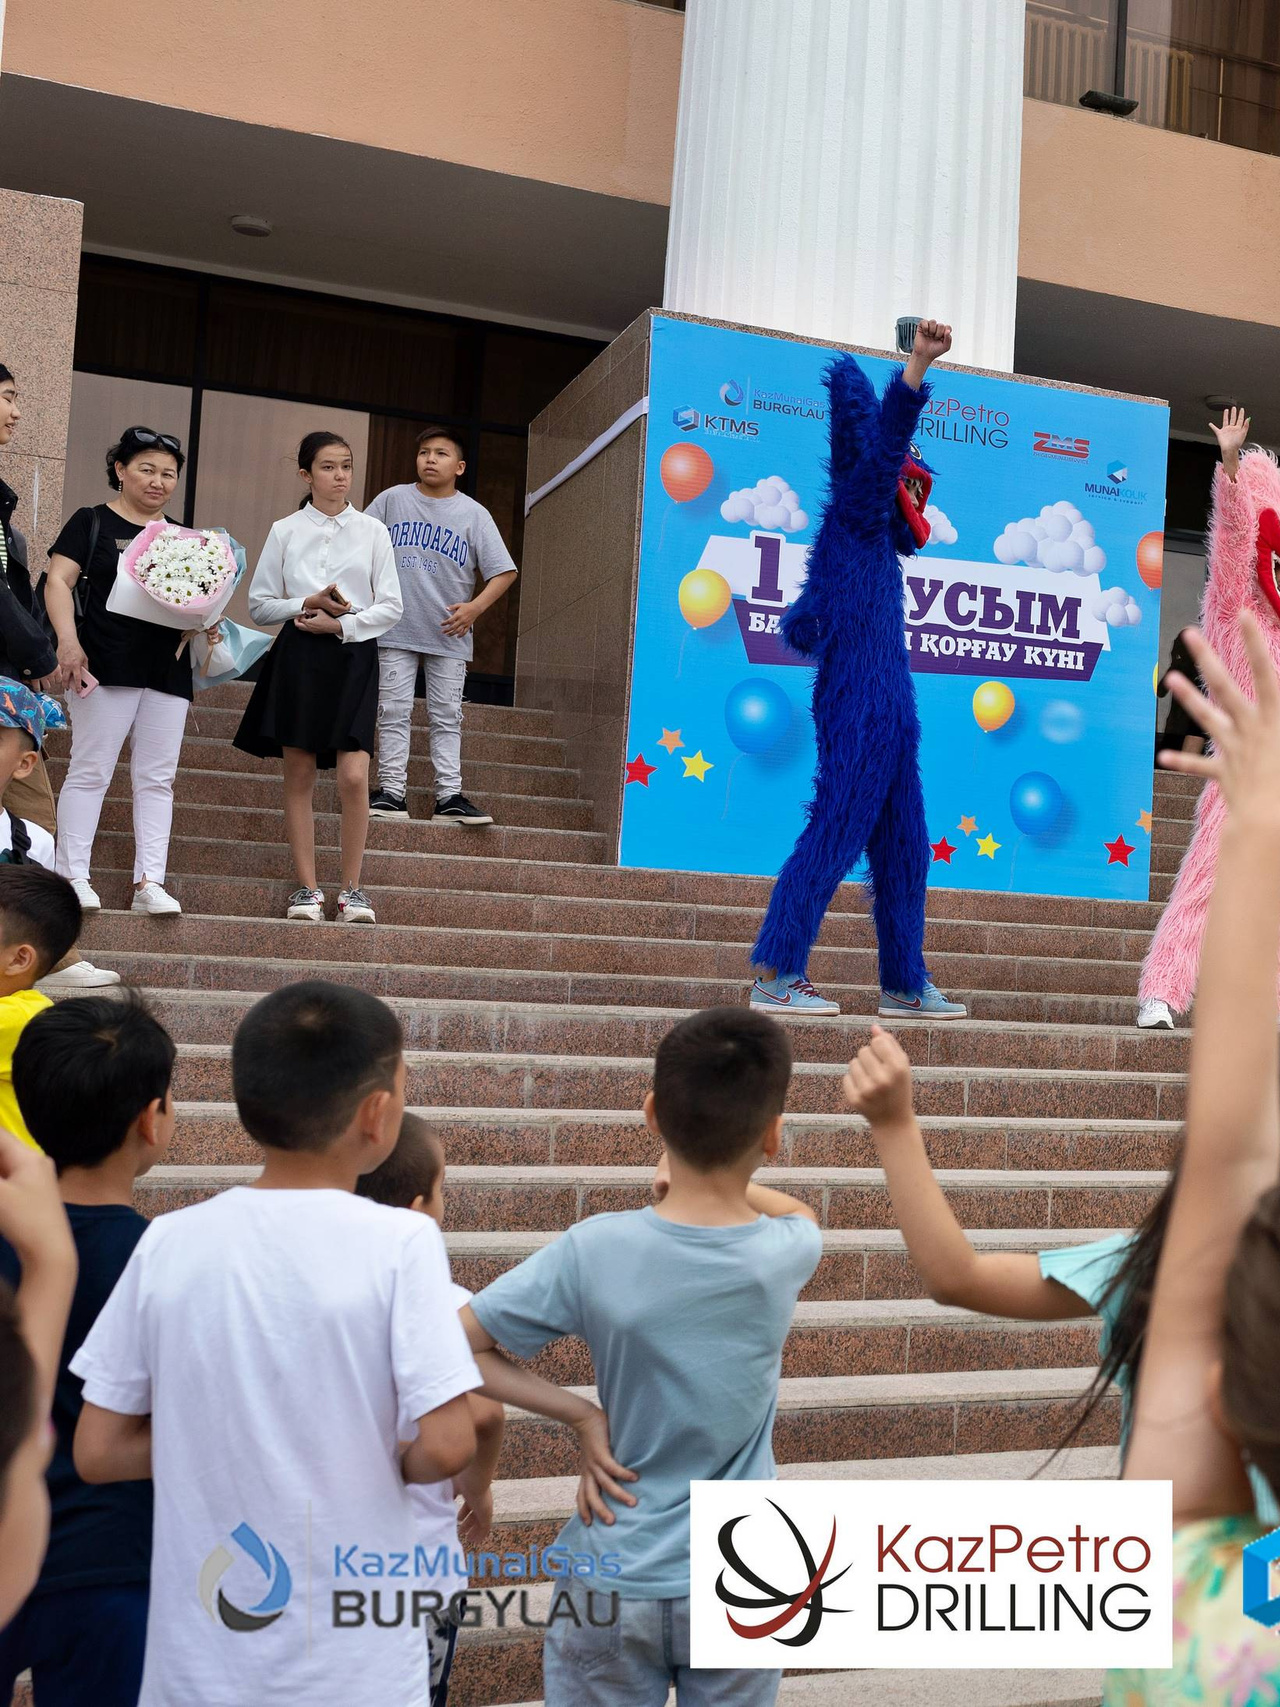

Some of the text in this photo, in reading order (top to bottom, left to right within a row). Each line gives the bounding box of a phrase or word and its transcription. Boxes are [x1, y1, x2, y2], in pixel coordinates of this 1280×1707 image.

[753, 400, 825, 420] BURGYLAU
[754, 389, 826, 408] KazMunaiGas
[921, 398, 1010, 427] azPetro
[705, 415, 759, 436] KTMS
[920, 417, 1009, 449] RILLING
[1033, 431, 1090, 459] ZMS
[1084, 483, 1148, 502] MUNAIKOLIK
[387, 521, 467, 568] ORNQAZAQ
[401, 556, 417, 568] EST
[751, 535, 783, 602] 1
[906, 575, 1082, 640] УСЫМ
[919, 632, 1085, 671] ҚОРҒАУ КҮНІ
